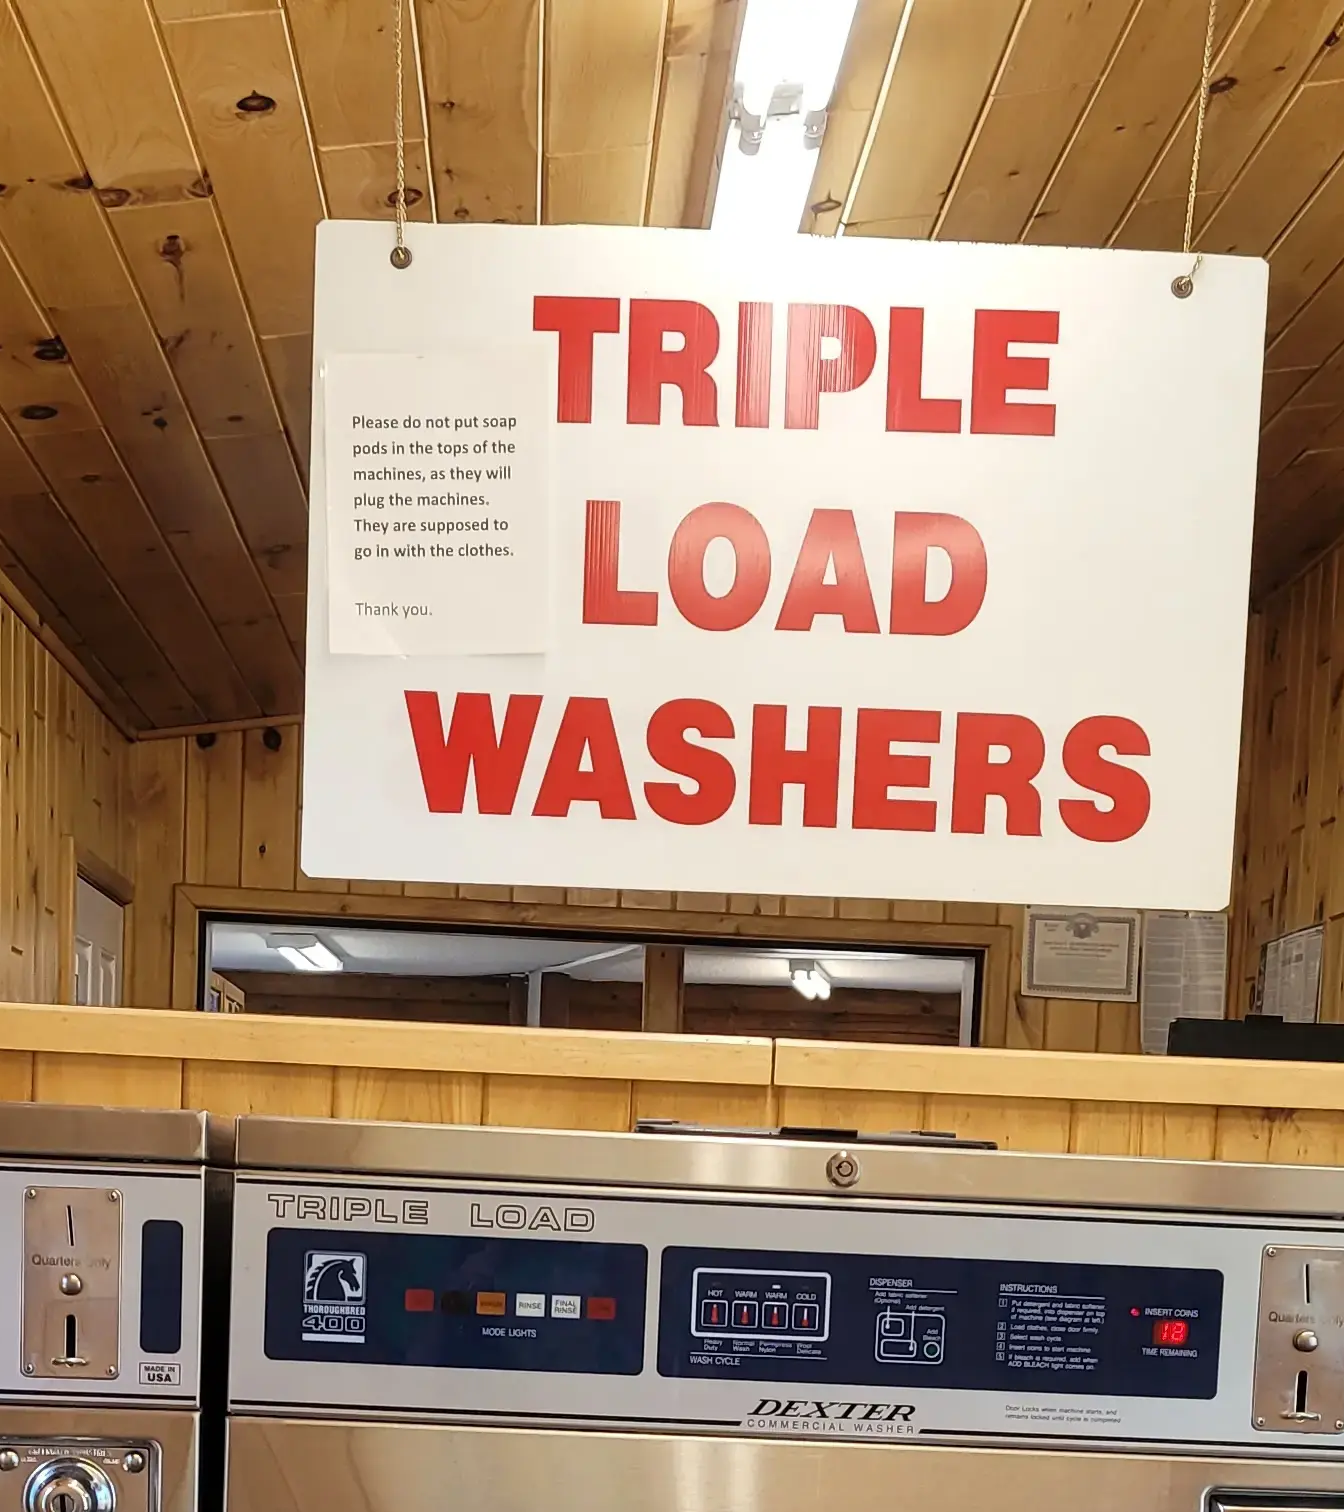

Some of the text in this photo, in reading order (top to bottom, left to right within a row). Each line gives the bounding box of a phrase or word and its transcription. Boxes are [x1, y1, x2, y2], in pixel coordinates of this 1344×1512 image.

[533, 295, 1060, 437] TRIPLE
[352, 415, 516, 431] Please do not put soap
[353, 440, 515, 457] pods in the tops of the
[354, 466, 511, 482] machines, as they will
[354, 493, 489, 509] plug the machines.
[354, 518, 508, 535] They are supposed to
[354, 544, 514, 560] go in with the clothes.
[582, 499, 988, 637] LOAD
[356, 602, 432, 619] Thank you.
[404, 690, 1151, 844] WASHERS
[268, 1193, 595, 1233] TRIPLE LOAD
[870, 1278, 912, 1287] DISPENSER
[1000, 1284, 1057, 1293] INSTRUCTIONS
[735, 1290, 757, 1298] WARM
[303, 1304, 365, 1315] THOROUGHBRED
[519, 1301, 542, 1310] RINSE
[554, 1306, 577, 1314] RINSE
[1145, 1308, 1198, 1318] INSERT COINS
[302, 1314, 365, 1333] 400
[482, 1327, 537, 1338] MODE LIGHTS
[690, 1356, 741, 1365] WASH CYCLE
[1142, 1348, 1197, 1358] TIME REMAINING
[147, 1373, 172, 1382] USA
[747, 1399, 916, 1421] DEXTER
[747, 1419, 914, 1434] COMMERCIAL WASHER
